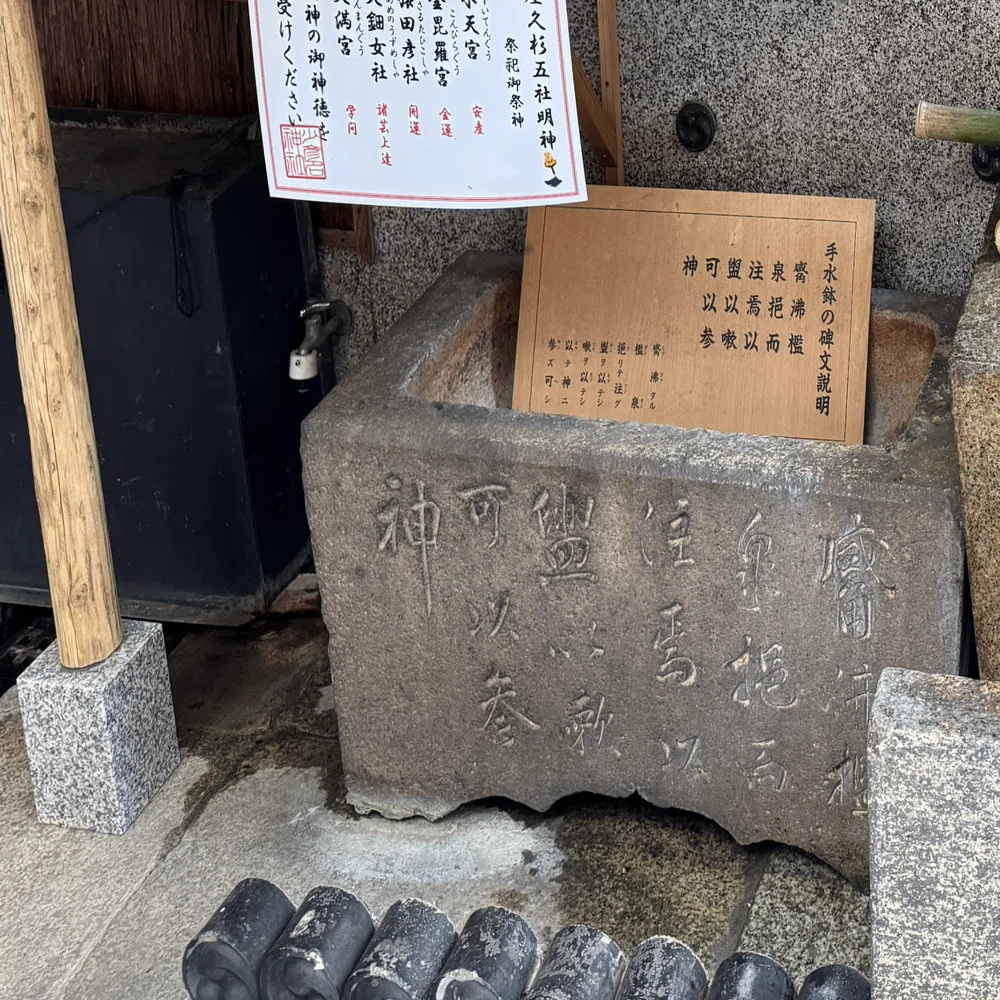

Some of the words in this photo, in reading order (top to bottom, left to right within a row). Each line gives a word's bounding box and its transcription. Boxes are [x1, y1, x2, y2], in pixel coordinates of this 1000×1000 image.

[505, 38, 524, 128] 祭祀御祭神
[346, 105, 357, 135] 学問
[377, 103, 392, 166] 諸芸上達
[409, 105, 421, 135] 開運
[440, 108, 452, 137] 金運
[473, 105, 483, 134] 安産
[683, 255, 698, 276] 神
[700, 258, 720, 348] 可以参
[816, 242, 838, 416] 手水鉢の碑文説明
[377, 473, 443, 615] 神
